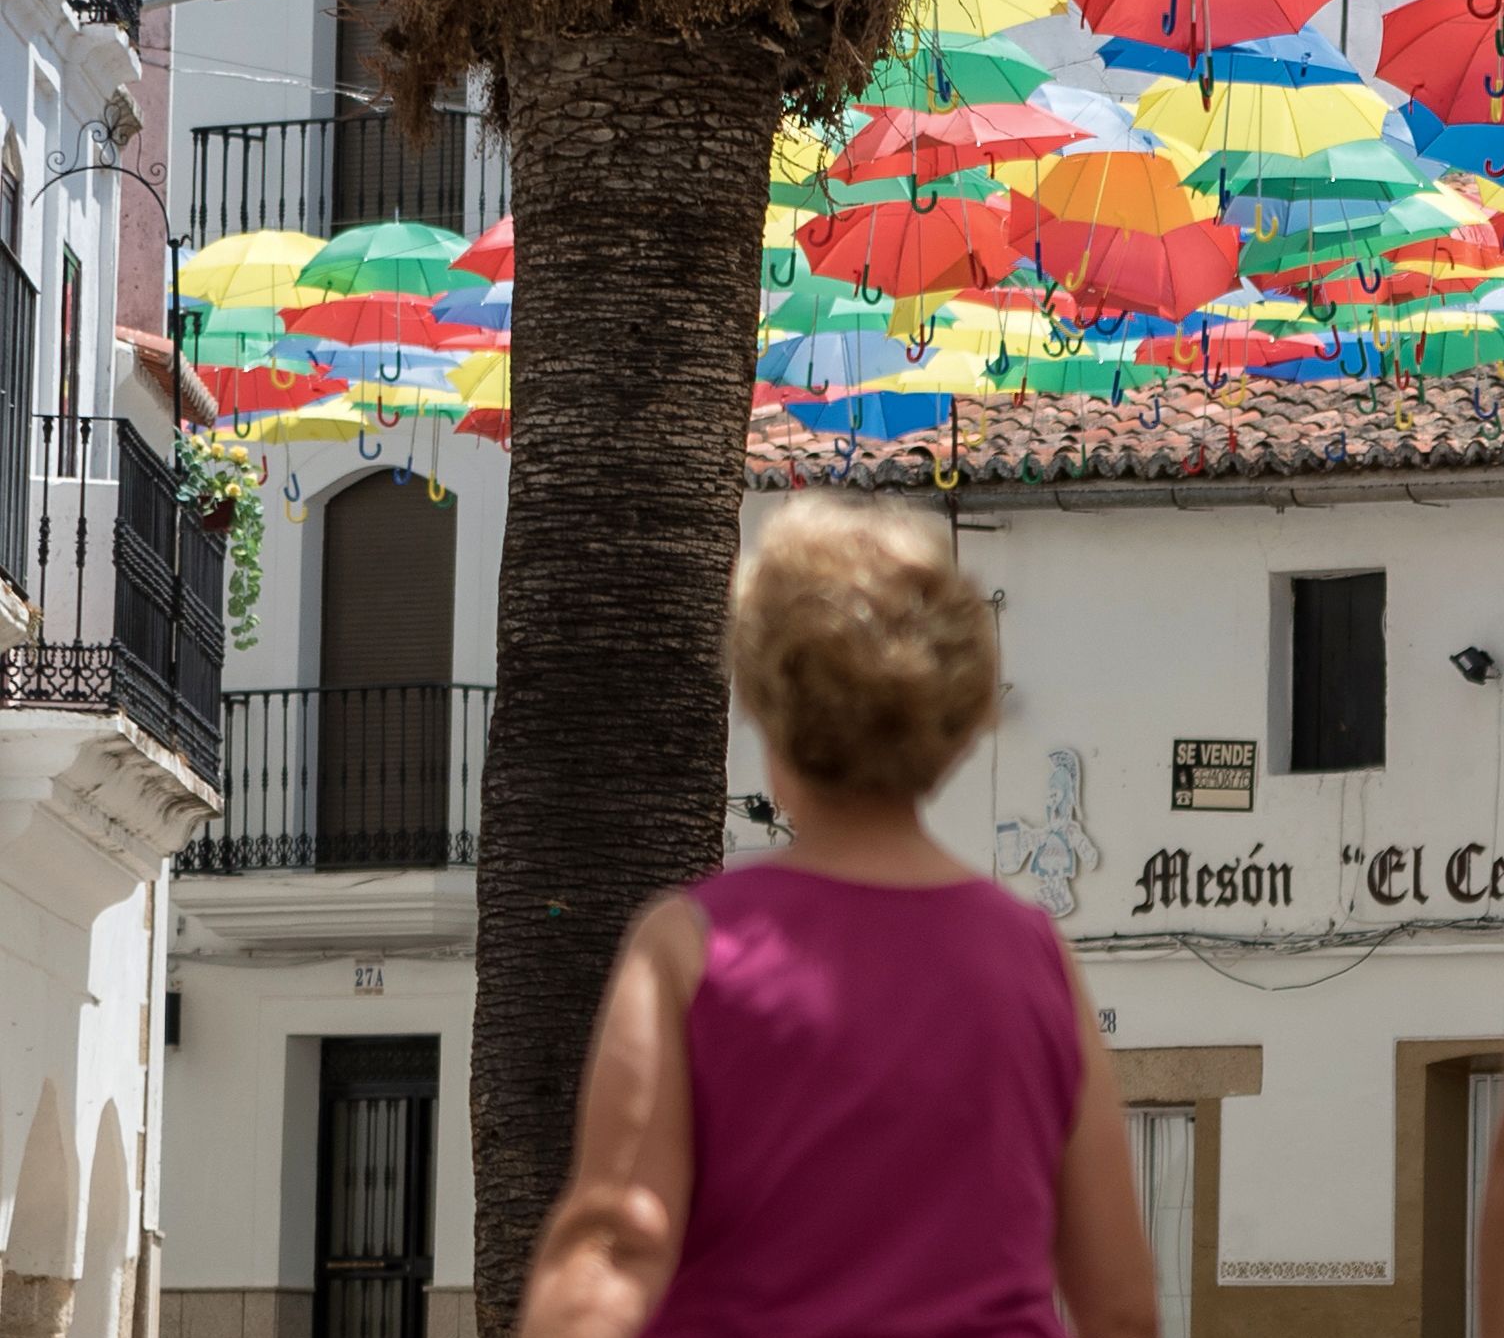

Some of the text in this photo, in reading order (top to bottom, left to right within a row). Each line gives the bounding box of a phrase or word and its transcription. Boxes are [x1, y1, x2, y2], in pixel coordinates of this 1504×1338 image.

[1176, 743, 1254, 766] SE VENDE
[1131, 842, 1294, 917] Mesón
[355, 967, 384, 987] 27A
[1098, 1010, 1117, 1034] 28
